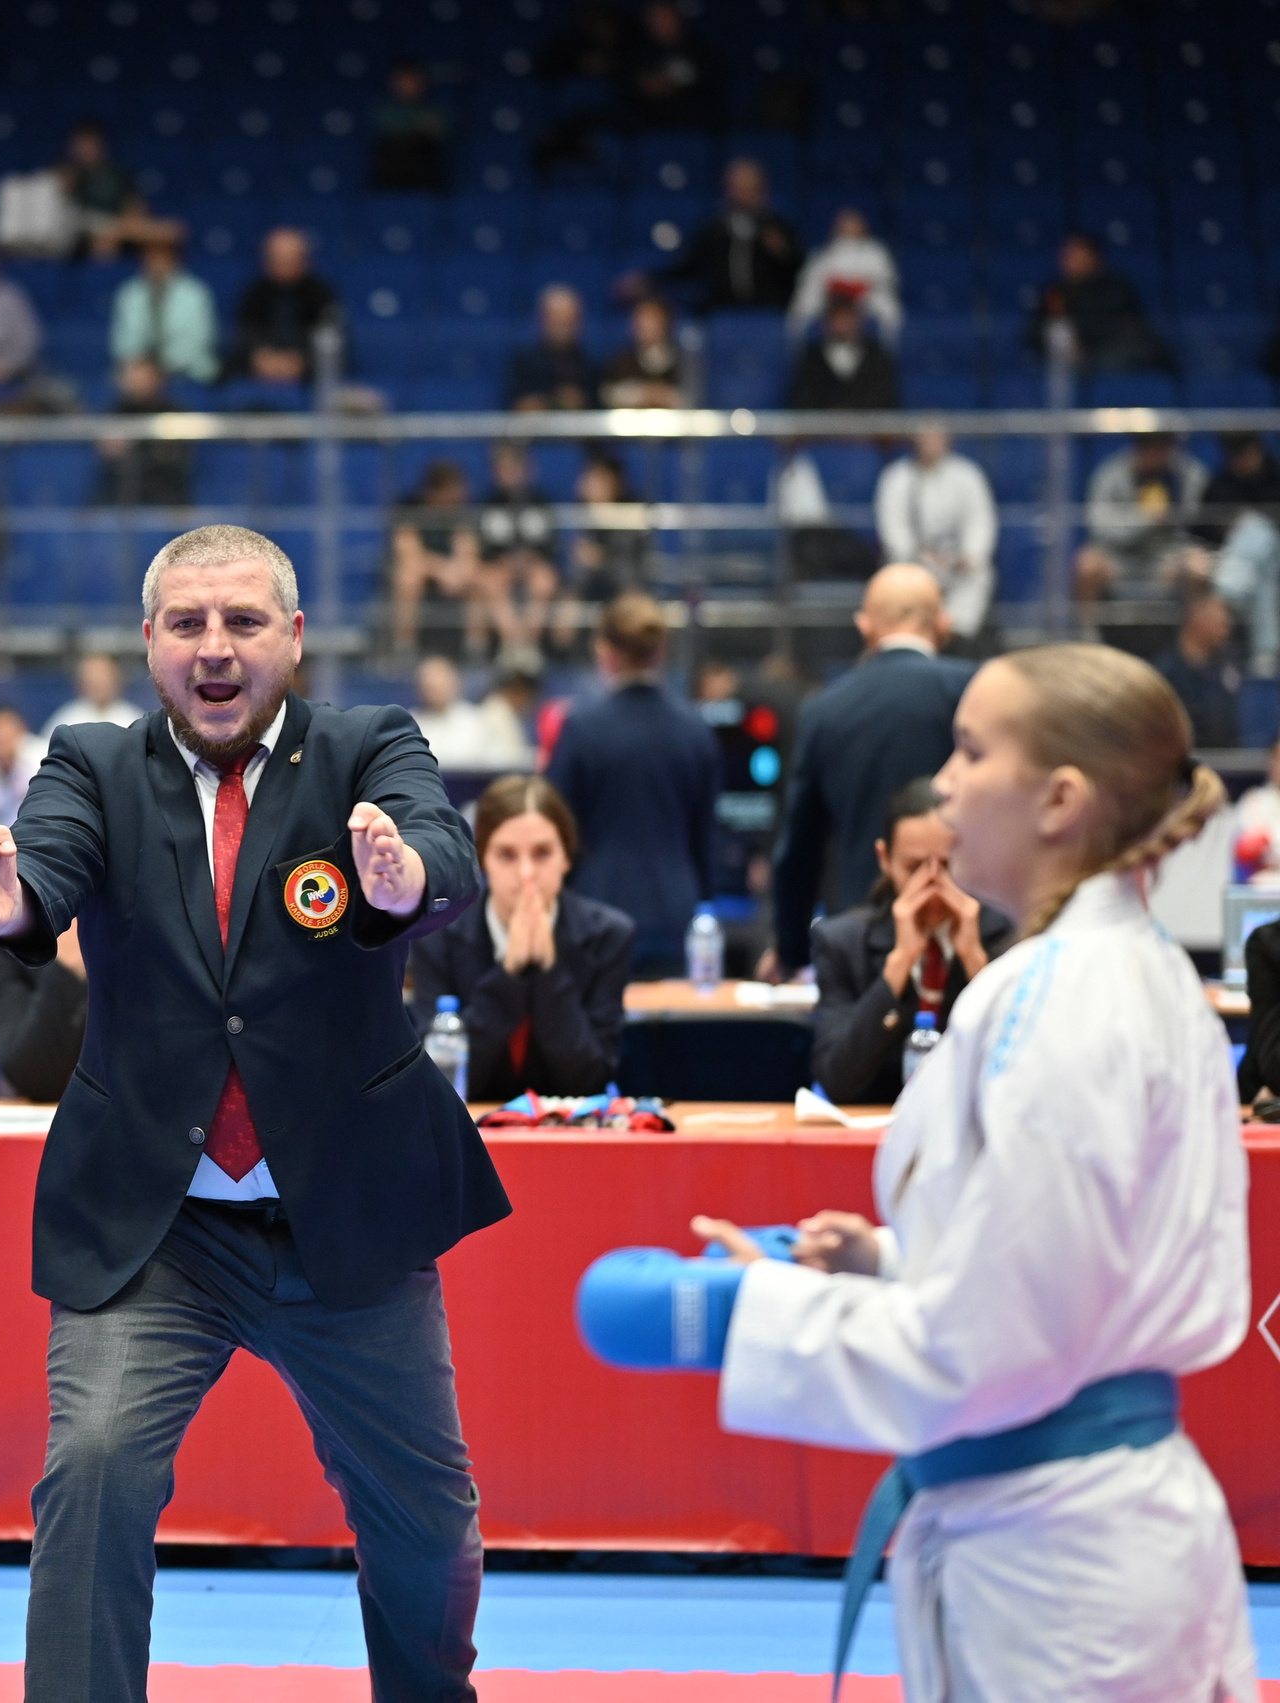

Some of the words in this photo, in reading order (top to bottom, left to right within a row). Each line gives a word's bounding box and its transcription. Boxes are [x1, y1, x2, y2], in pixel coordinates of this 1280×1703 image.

[295, 863, 326, 876] WORLD
[306, 888, 326, 902] WKF
[288, 902, 313, 926] KARATE
[316, 887, 347, 926] FEDERATION
[313, 926, 339, 939] JUDGE
